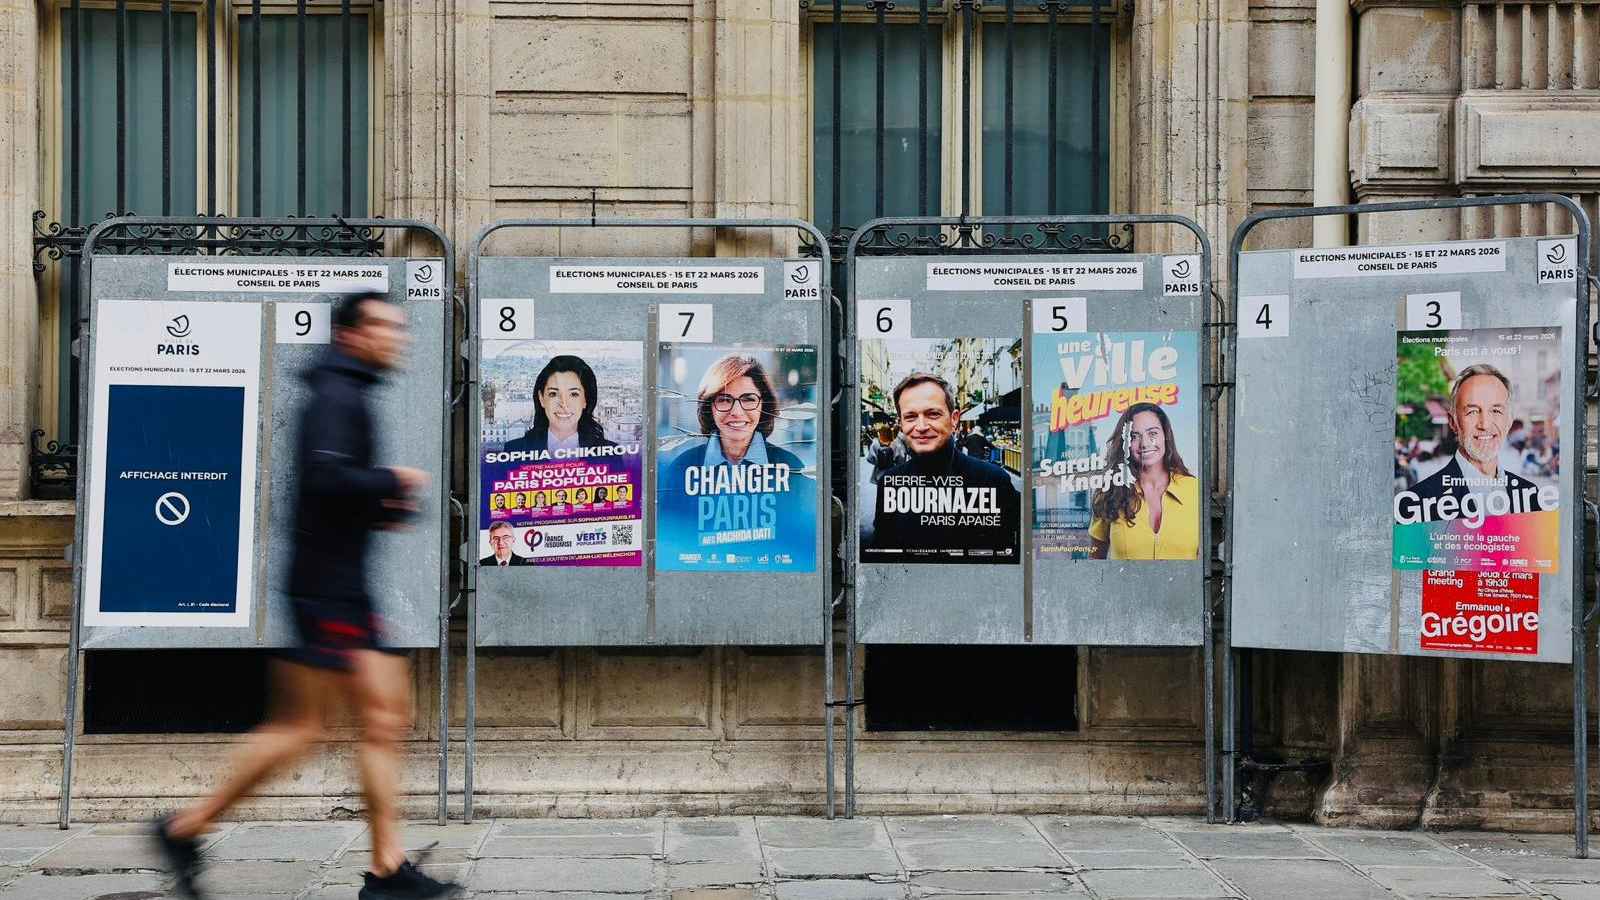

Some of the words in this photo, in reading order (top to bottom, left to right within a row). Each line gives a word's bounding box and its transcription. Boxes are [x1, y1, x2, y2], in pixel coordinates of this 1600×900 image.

[1349, 252, 1406, 261] MUNICIPALES
[933, 267, 982, 275] ÉLECTIONS
[1358, 263, 1395, 271] CONSEIL
[1540, 269, 1574, 280] PARIS
[408, 288, 440, 297] PARIS
[785, 289, 817, 298] PARIS
[1165, 284, 1199, 293] PARIS
[499, 306, 516, 332] 8
[876, 307, 893, 333] 6
[1051, 306, 1068, 332] 5
[1256, 304, 1272, 329] 4
[1426, 301, 1442, 328] 3
[294, 310, 312, 336] 9
[678, 312, 695, 337] 7
[157, 344, 200, 355] PARIS
[1058, 340, 1091, 354] une
[1434, 347, 1460, 356] Paris
[1060, 335, 1178, 389] ville
[1051, 383, 1179, 432] heureuse
[485, 451, 552, 464] SOPHIA
[554, 444, 639, 458] CHIKIROU
[1040, 452, 1106, 477] Sarah
[120, 471, 178, 479] AFFICHAGE
[181, 472, 228, 480] INTERDIT
[510, 472, 528, 481] LE
[532, 466, 607, 479] NOUVEAU
[684, 463, 790, 496] CHANGER
[495, 480, 539, 490] PARIS
[542, 474, 627, 487] POPULAIRE
[884, 476, 963, 486] PIERRE-YVES
[1442, 475, 1508, 486] Emmanuel
[884, 487, 1000, 514] BOURNAZEL
[1394, 479, 1559, 529] Grégoire
[698, 494, 776, 531] PARIS
[920, 516, 956, 526] PARIS
[958, 513, 1000, 526] APAISÉ
[576, 532, 607, 541] VERTS
[753, 528, 770, 540] DATI
[1430, 533, 1460, 542] L'union
[1477, 534, 1484, 542] la
[1487, 534, 1520, 544] gauche
[1464, 542, 1515, 552] écologistes
[1428, 577, 1463, 588] meeting
[1478, 578, 1482, 586] à
[1485, 579, 1508, 587] 19h30
[1455, 602, 1503, 612] Emmanuel
[1421, 606, 1539, 641] Grégoire
